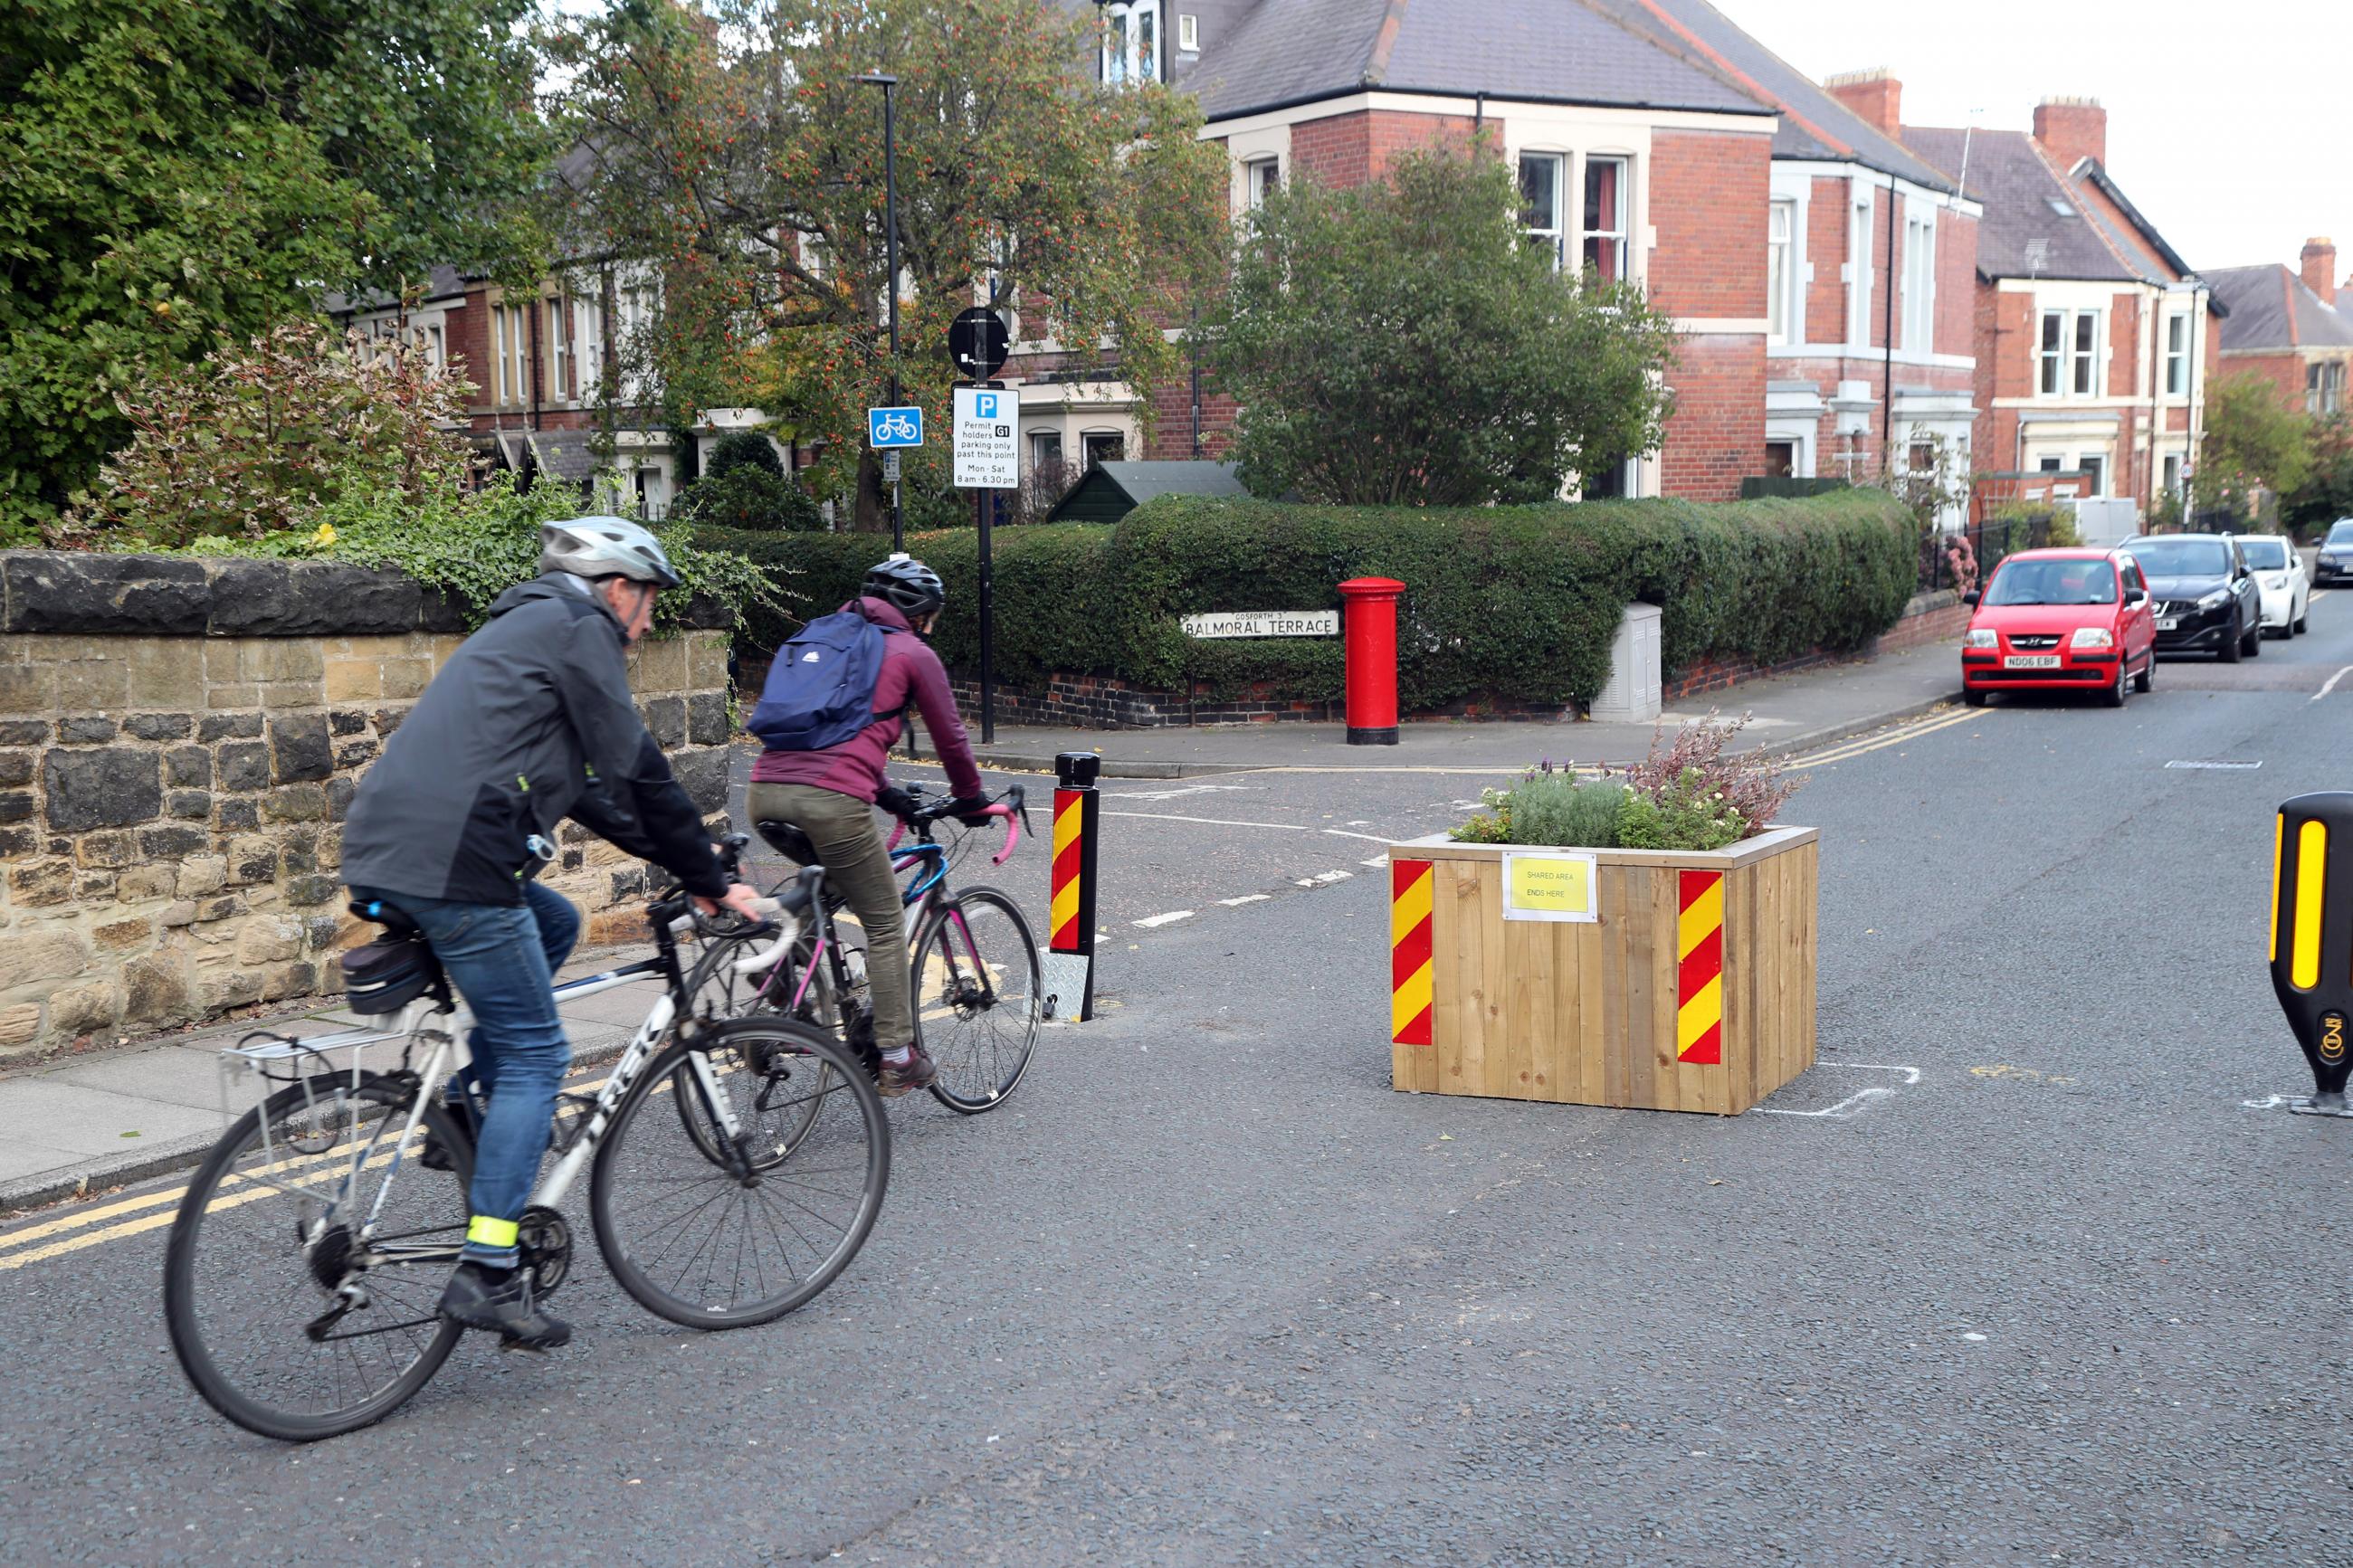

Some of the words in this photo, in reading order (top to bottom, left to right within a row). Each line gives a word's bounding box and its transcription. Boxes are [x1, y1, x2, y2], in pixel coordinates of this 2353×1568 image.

[980, 396, 995, 416] P
[965, 421, 991, 430] Permit
[962, 431, 993, 439] holders
[996, 426, 1008, 436] G1
[961, 442, 992, 451] parking
[994, 442, 1011, 451] only
[957, 451, 975, 459] past
[977, 451, 992, 459] this
[995, 451, 1015, 460] point
[967, 464, 986, 472] Mon
[991, 464, 1005, 473] Sat
[982, 475, 1002, 484] 6.30
[1003, 477, 1015, 485] pm
[1235, 613, 1273, 621] GOSFORTH
[1186, 621, 1262, 636] BALMORAL
[1268, 620, 1332, 634] TERRACE
[1528, 889, 1545, 897] ENDS
[1546, 889, 1565, 898] HERE
